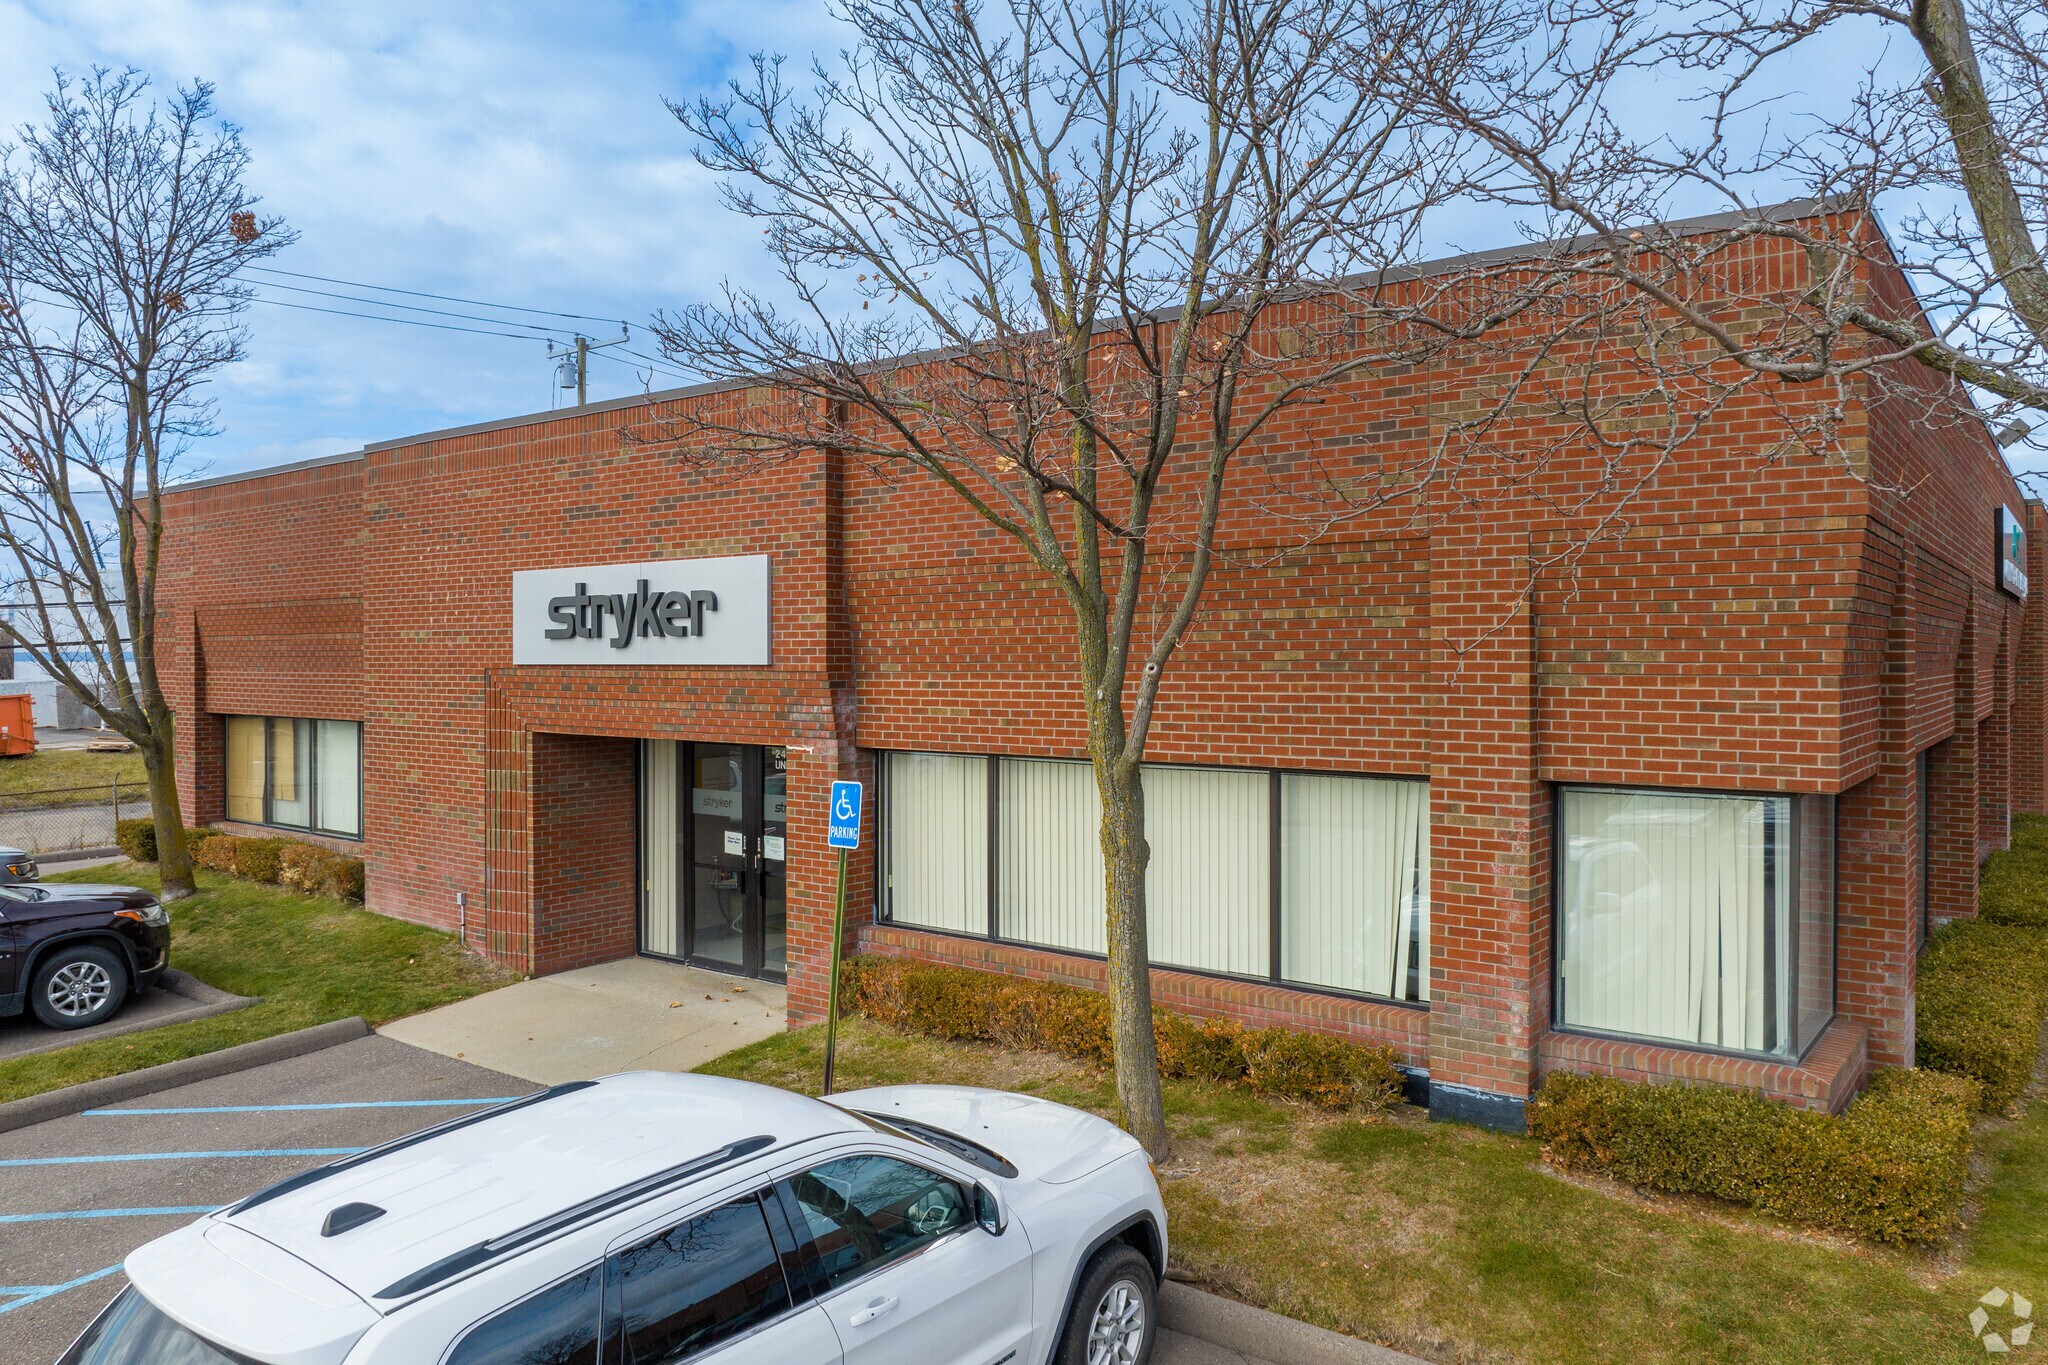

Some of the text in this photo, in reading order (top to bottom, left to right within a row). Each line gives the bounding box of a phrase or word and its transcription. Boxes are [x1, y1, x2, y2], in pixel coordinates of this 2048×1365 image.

[545, 579, 718, 649] stryker
[702, 795, 733, 809] stryker
[830, 825, 858, 840] PARKING
